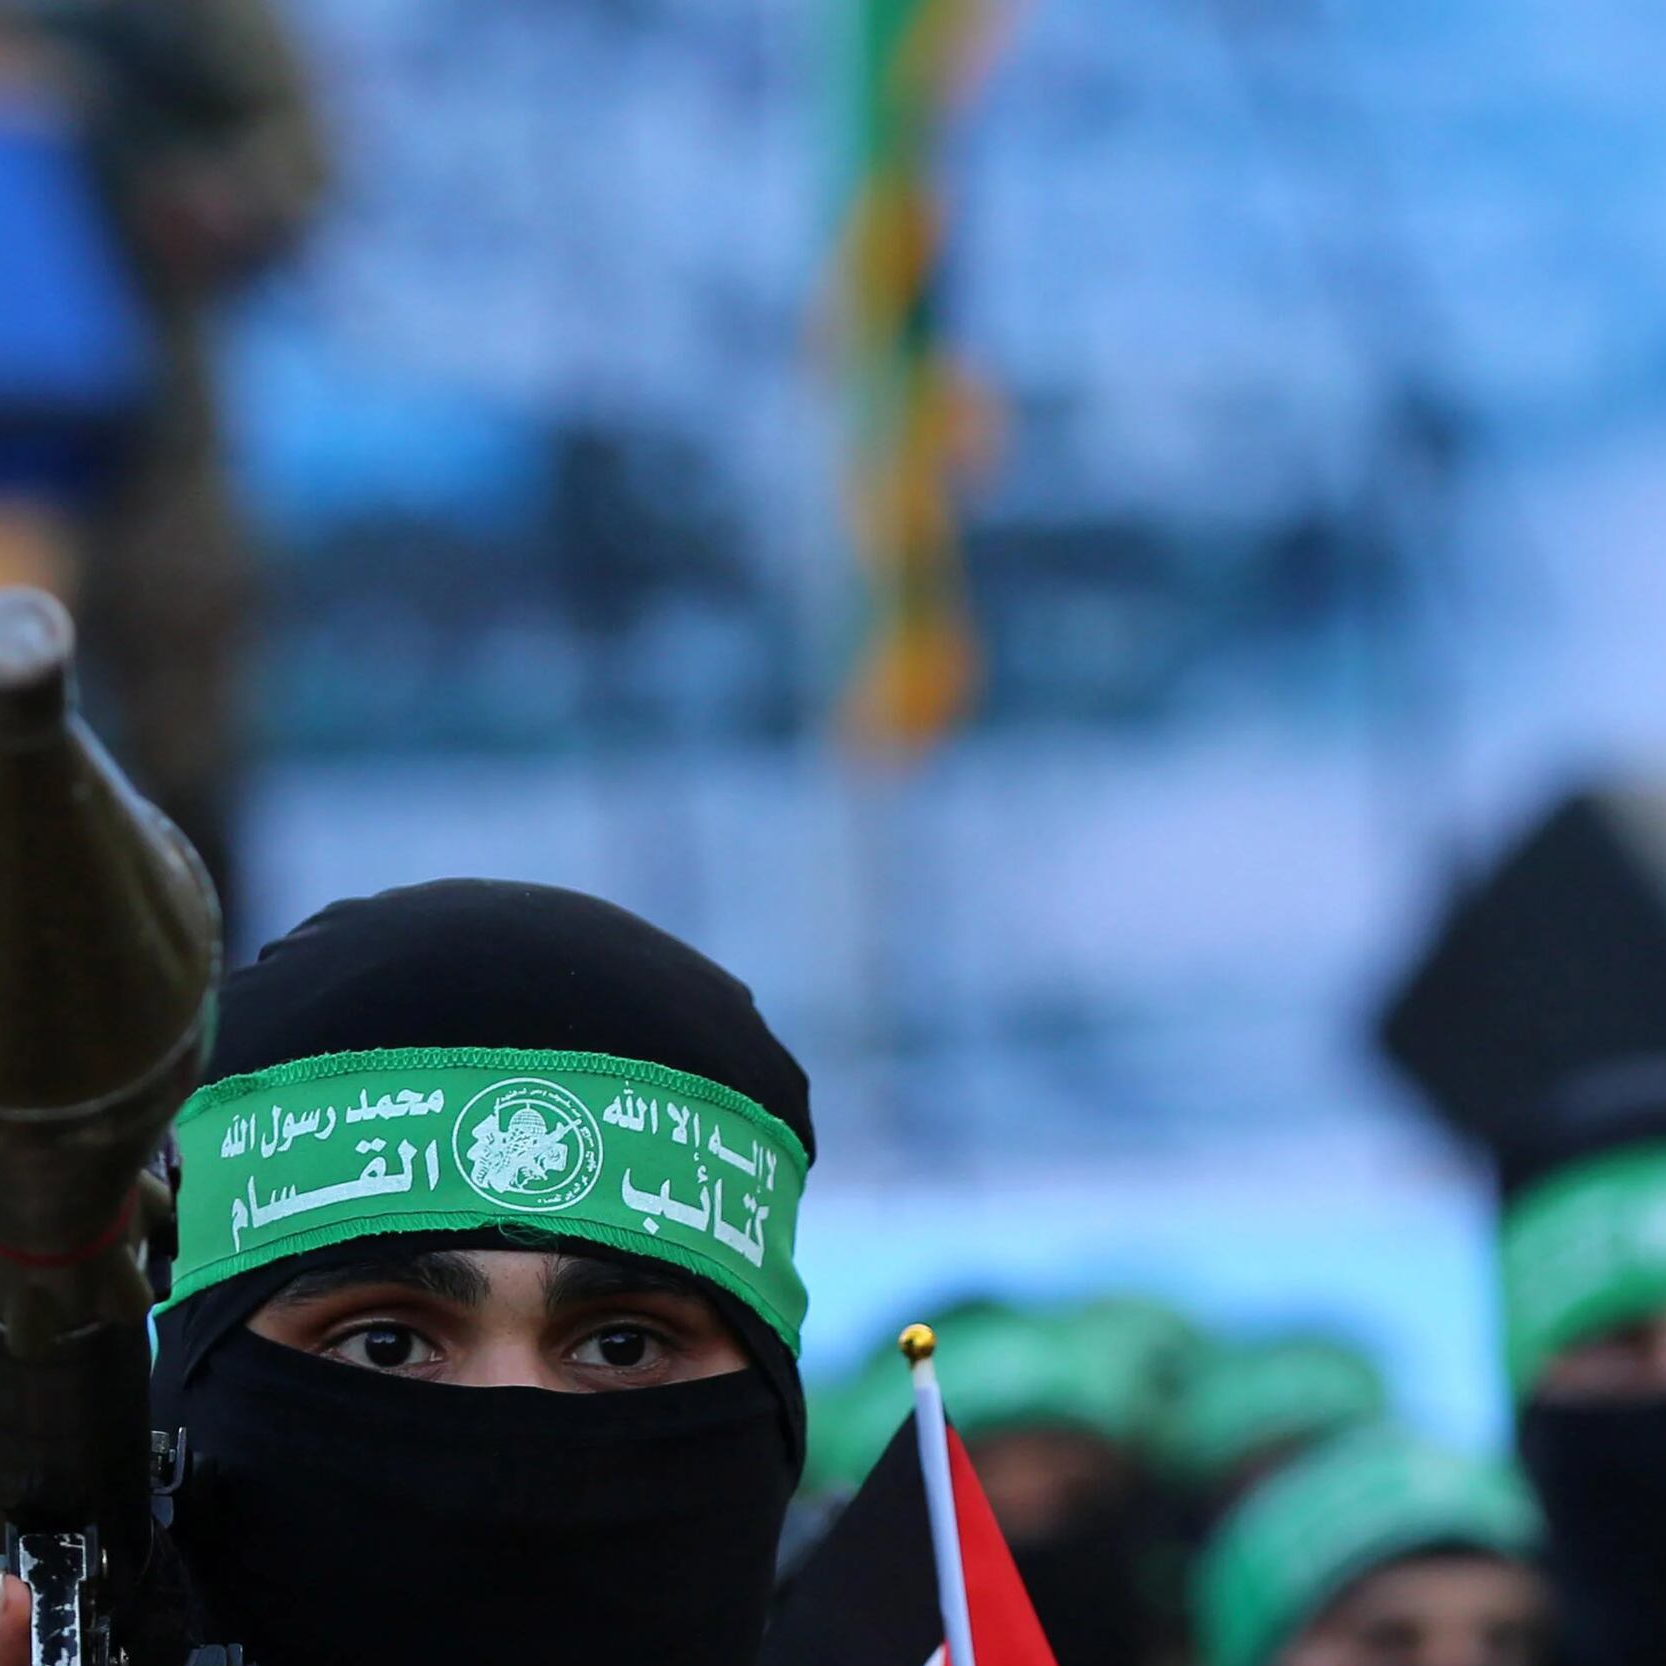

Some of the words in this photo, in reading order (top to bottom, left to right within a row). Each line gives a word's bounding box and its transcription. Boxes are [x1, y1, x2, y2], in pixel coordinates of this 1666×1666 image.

[260, 1105, 337, 1159] رسول
[345, 1088, 445, 1123] محمد
[602, 1080, 659, 1135] الله
[666, 1101, 702, 1162] إلا
[220, 1112, 256, 1159] الله
[230, 1137, 441, 1253] القسام
[621, 1164, 770, 1269] كتائب
